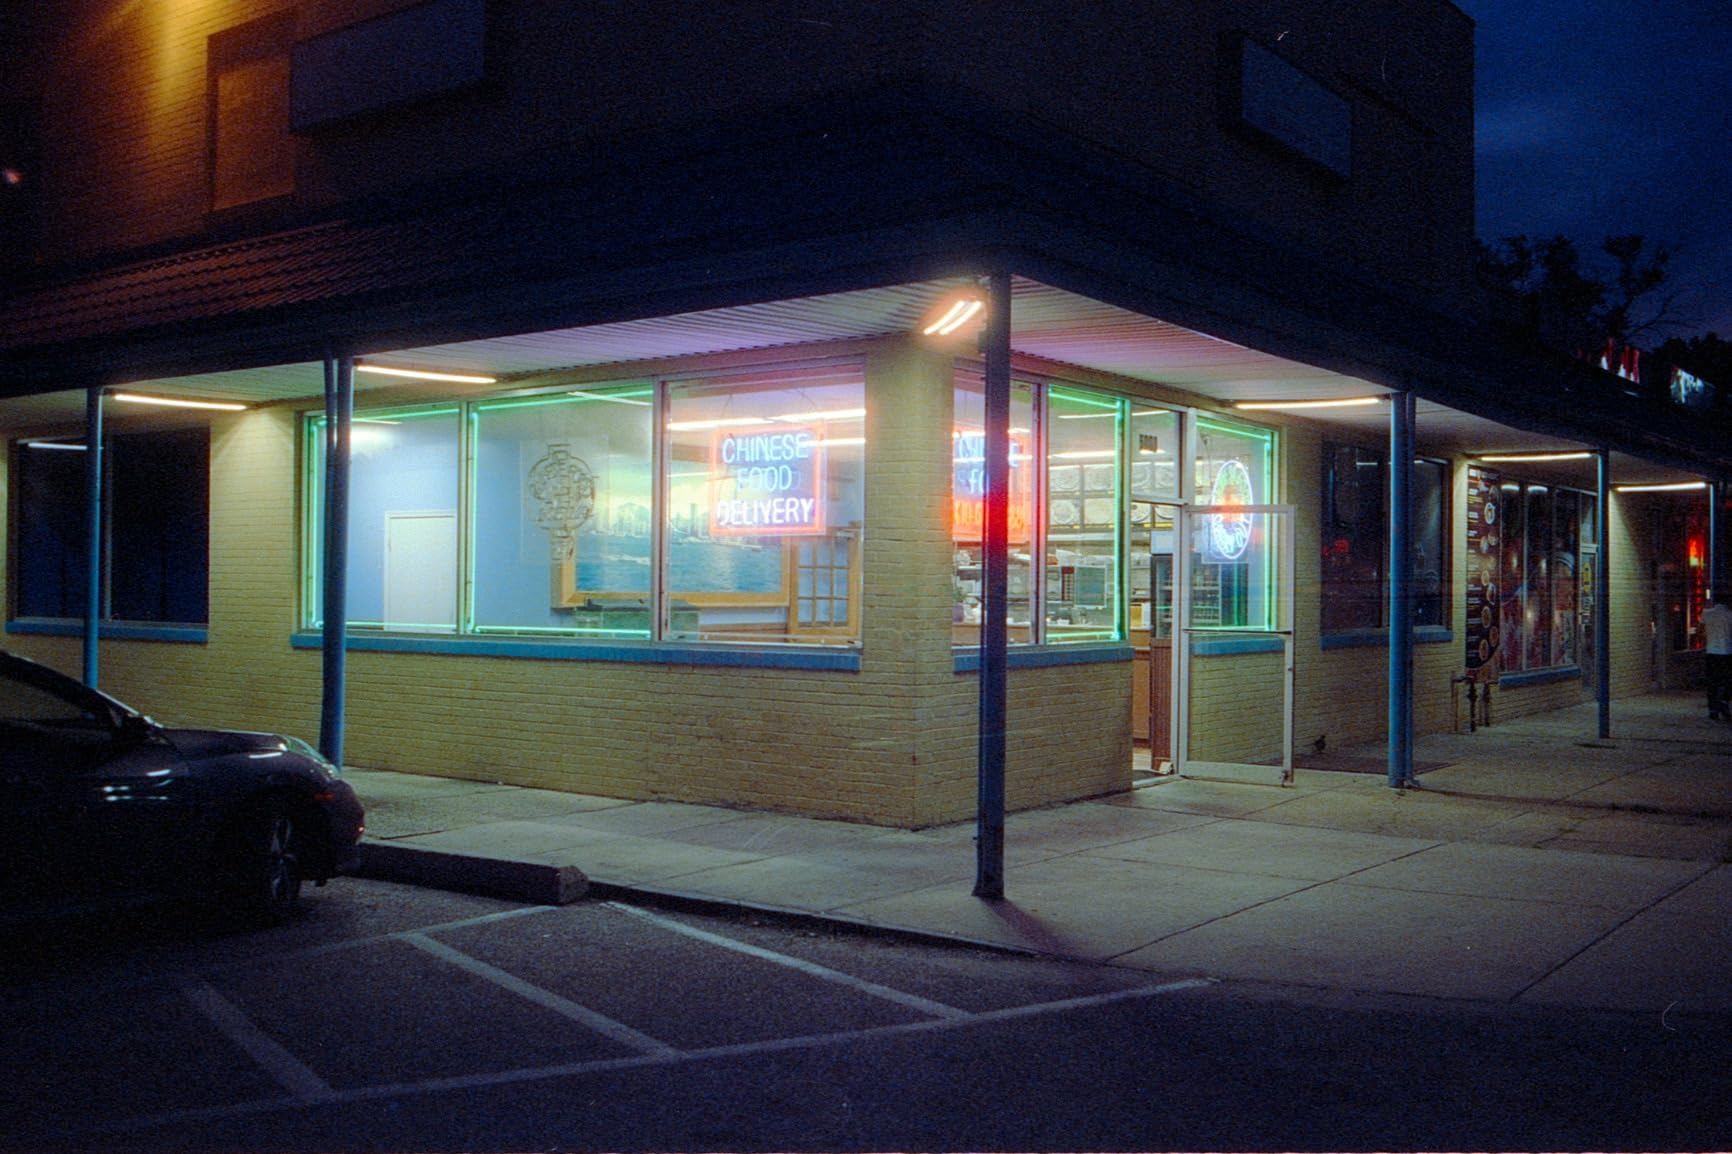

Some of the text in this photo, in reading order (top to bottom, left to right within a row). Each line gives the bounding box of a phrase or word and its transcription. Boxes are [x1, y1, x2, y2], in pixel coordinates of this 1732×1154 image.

[722, 433, 809, 464] CHINESE
[737, 465, 793, 491] FOOD
[717, 497, 814, 526] DELIVERY
